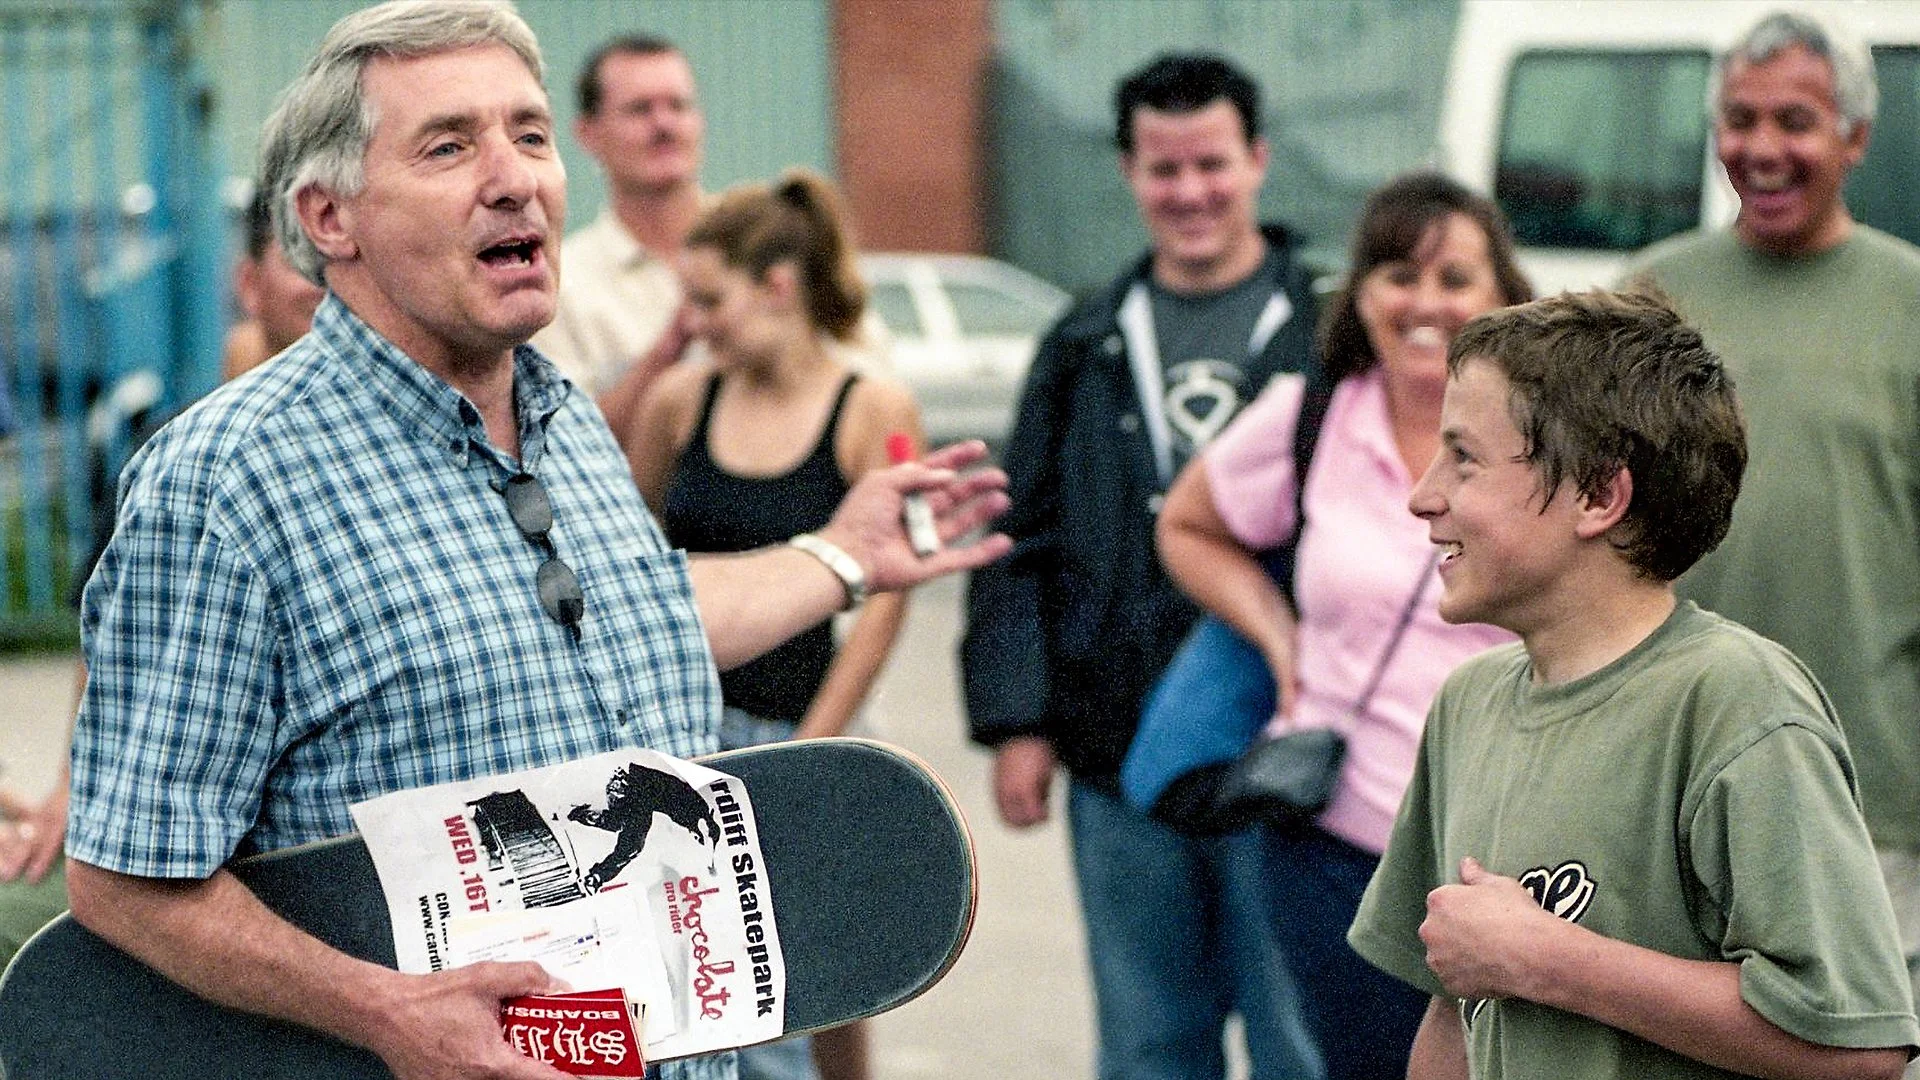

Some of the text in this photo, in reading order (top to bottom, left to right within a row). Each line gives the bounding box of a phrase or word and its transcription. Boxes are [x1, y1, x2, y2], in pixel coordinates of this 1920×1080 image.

[444, 815, 477, 865] WED
[663, 881, 683, 935] pro rider
[709, 778, 776, 1018] rdiff Skatepark
[679, 876, 735, 1021] chocolate
